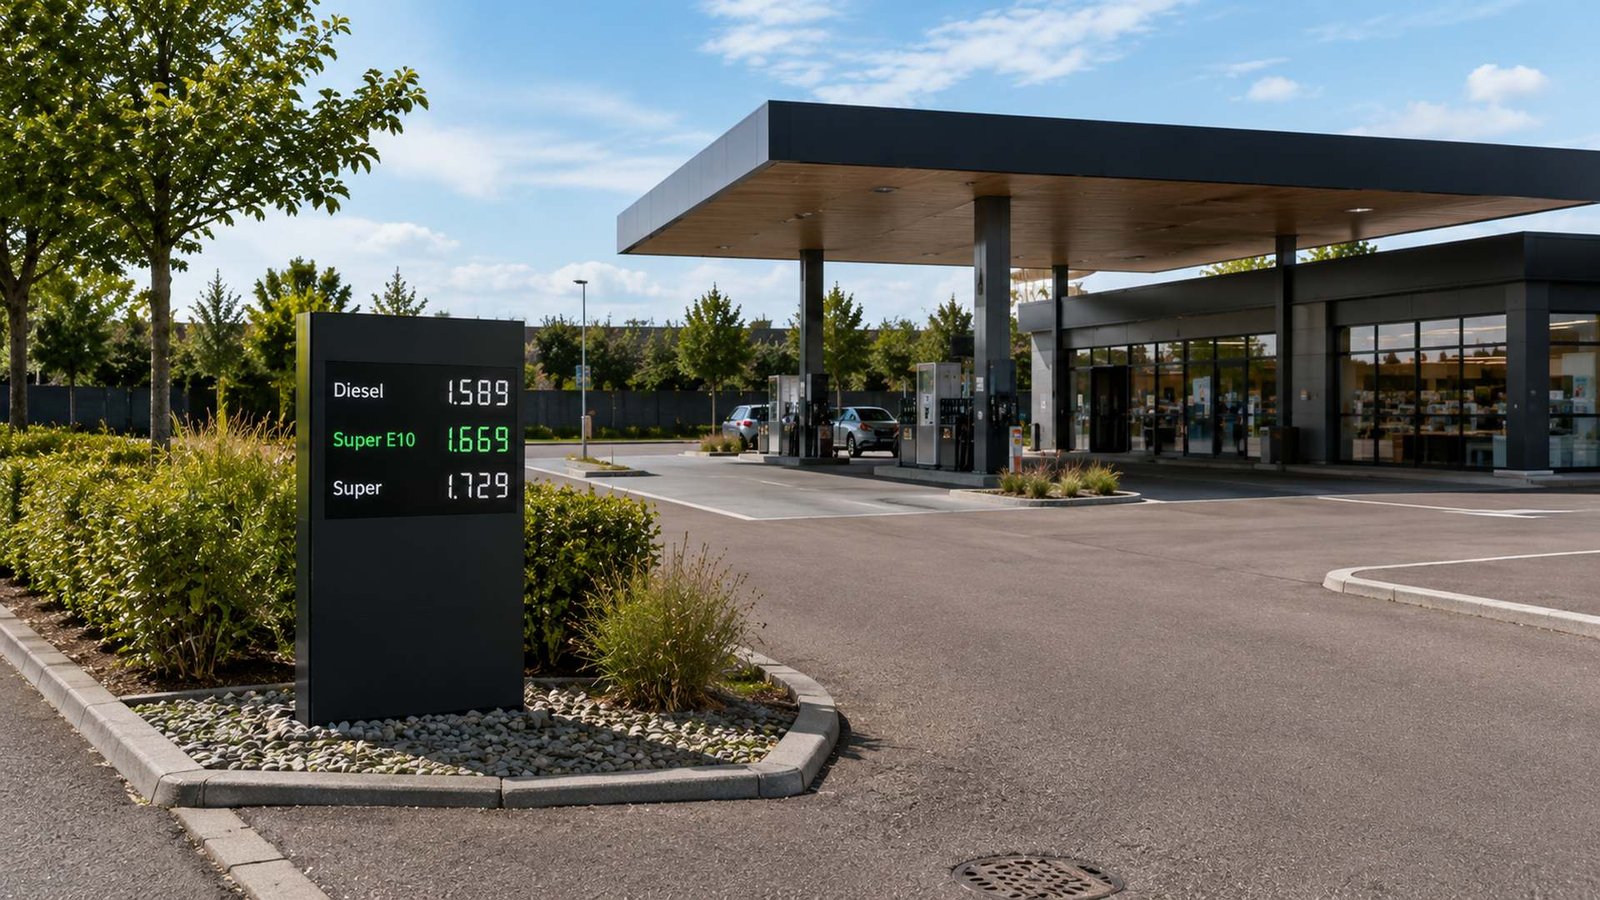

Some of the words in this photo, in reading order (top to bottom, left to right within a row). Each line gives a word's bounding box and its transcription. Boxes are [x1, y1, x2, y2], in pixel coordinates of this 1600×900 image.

[334, 382, 384, 398] Diesel
[449, 379, 509, 406] 1.589
[333, 432, 382, 450] Super
[387, 432, 416, 447] E10
[449, 426, 509, 452] 1.669
[333, 481, 382, 499] Super
[449, 473, 509, 499] 1.729
